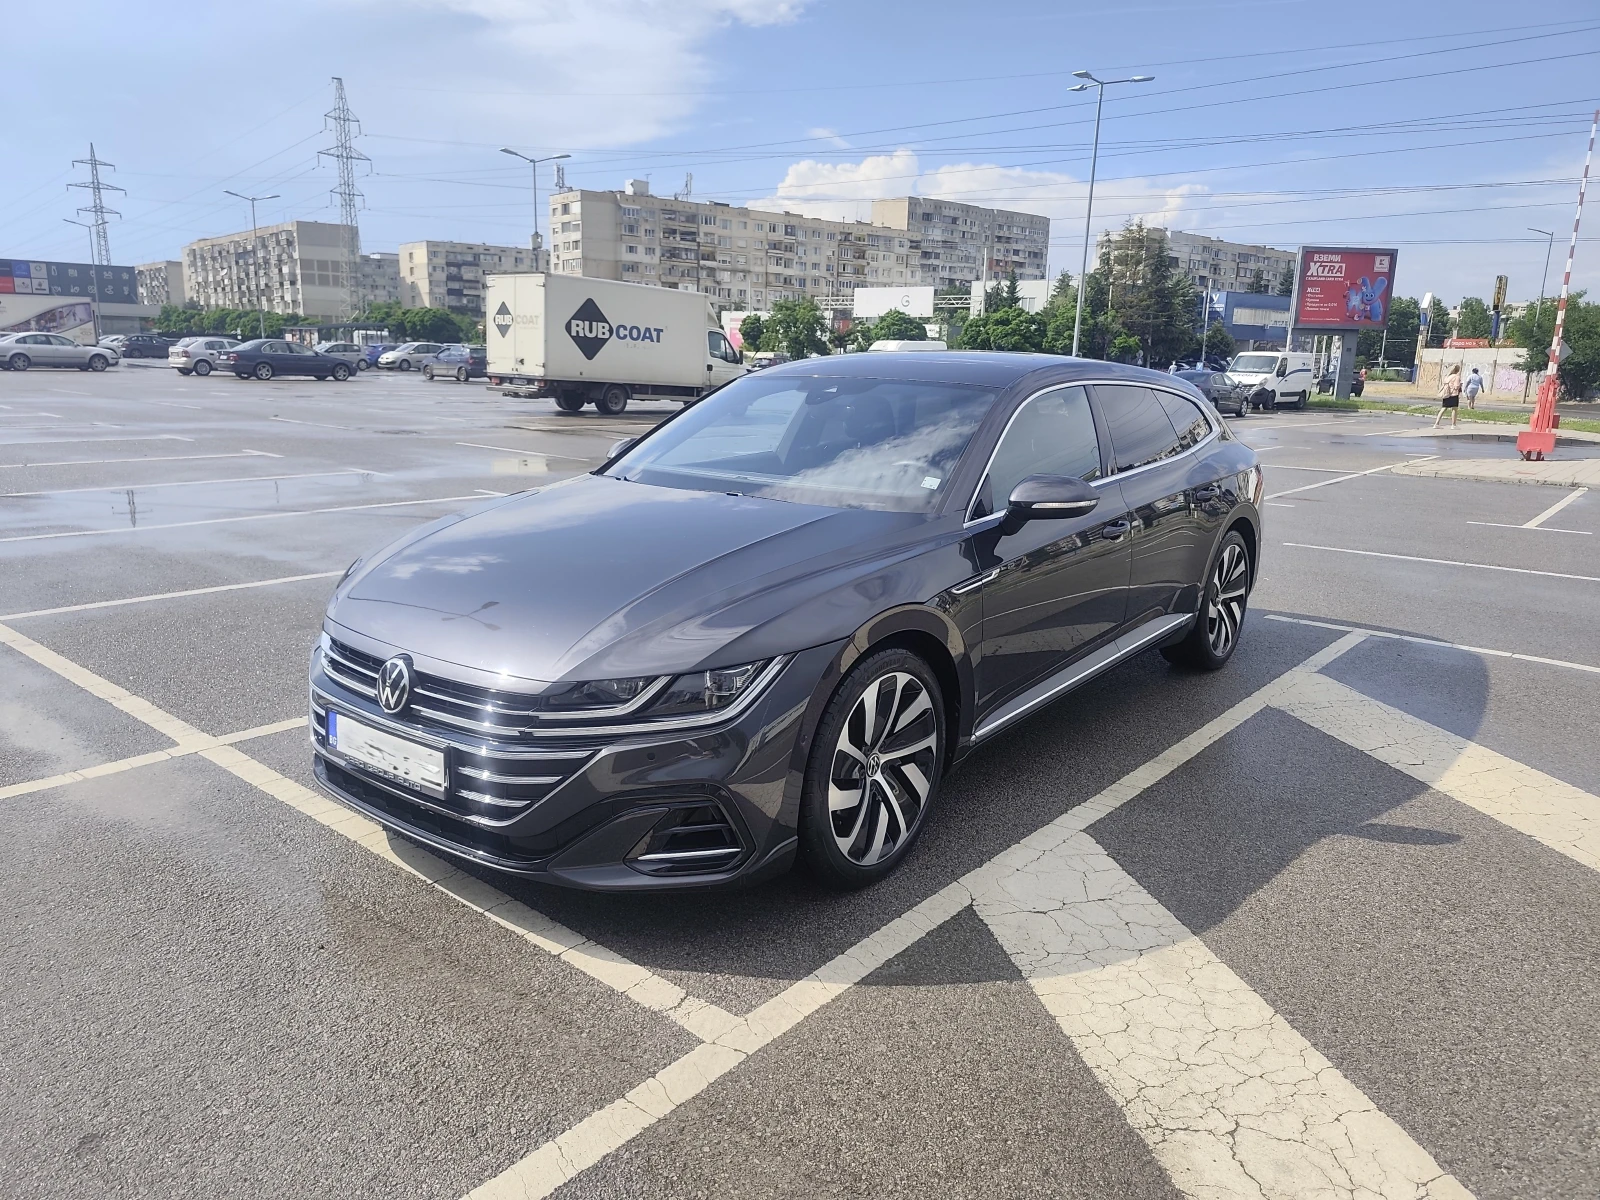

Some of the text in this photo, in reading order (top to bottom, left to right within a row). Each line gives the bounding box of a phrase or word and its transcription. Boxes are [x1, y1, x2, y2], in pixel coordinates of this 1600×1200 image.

[1314, 254, 1342, 262] ВЗЕМИ
[1306, 262, 1344, 276] XTRA
[495, 314, 540, 325] RUB COAT
[570, 319, 664, 343] RUB COAT
[329, 734, 337, 745] BG
